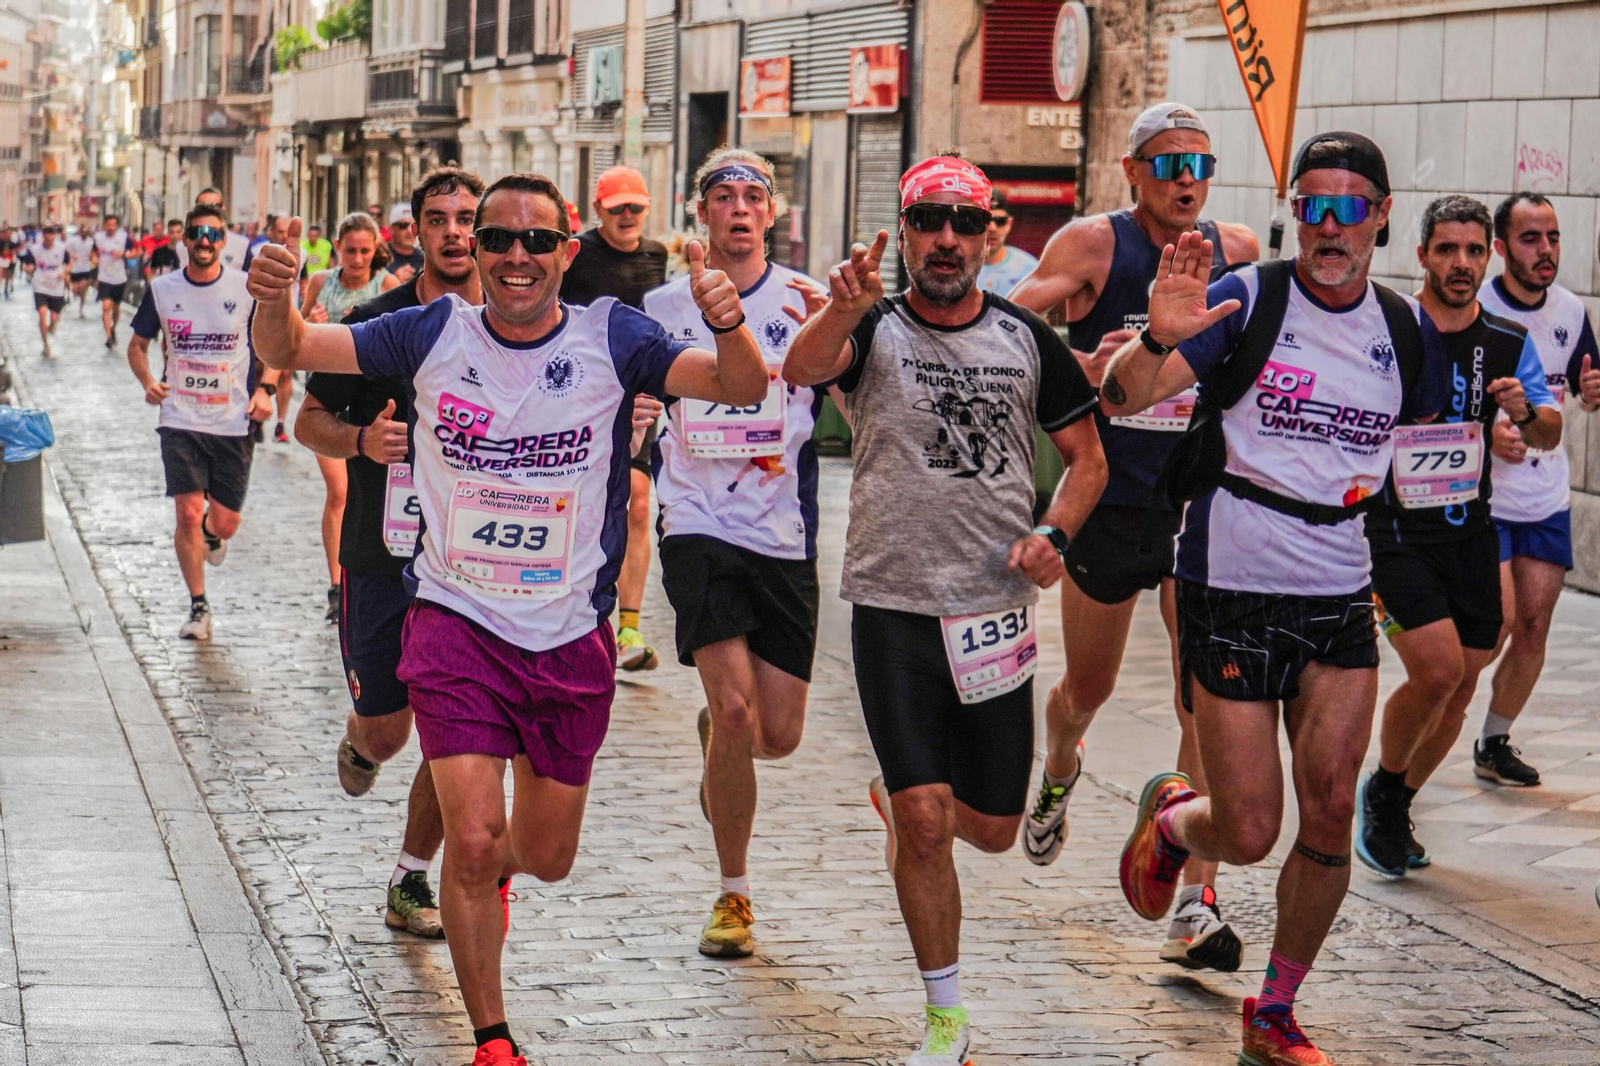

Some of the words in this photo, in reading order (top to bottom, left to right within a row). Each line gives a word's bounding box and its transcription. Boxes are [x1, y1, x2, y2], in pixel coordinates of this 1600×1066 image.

[185, 376, 219, 389] 994
[963, 366, 980, 377] DE
[983, 366, 1025, 378] FONDO
[1261, 367, 1313, 393] 10ª
[1471, 346, 1484, 417] ciclismo
[442, 403, 490, 429] 10ª
[434, 424, 593, 456] CARRERA
[442, 445, 590, 471] UNIVERSIDAD
[1410, 450, 1467, 472] 779
[526, 470, 565, 478] DISTANCIA
[566, 468, 576, 476] 10
[577, 465, 589, 473] KM
[480, 488, 550, 505] CARRERA
[480, 498, 530, 512] UNIVERSIDAD
[472, 520, 549, 551] 433
[961, 606, 1029, 655] 1331
